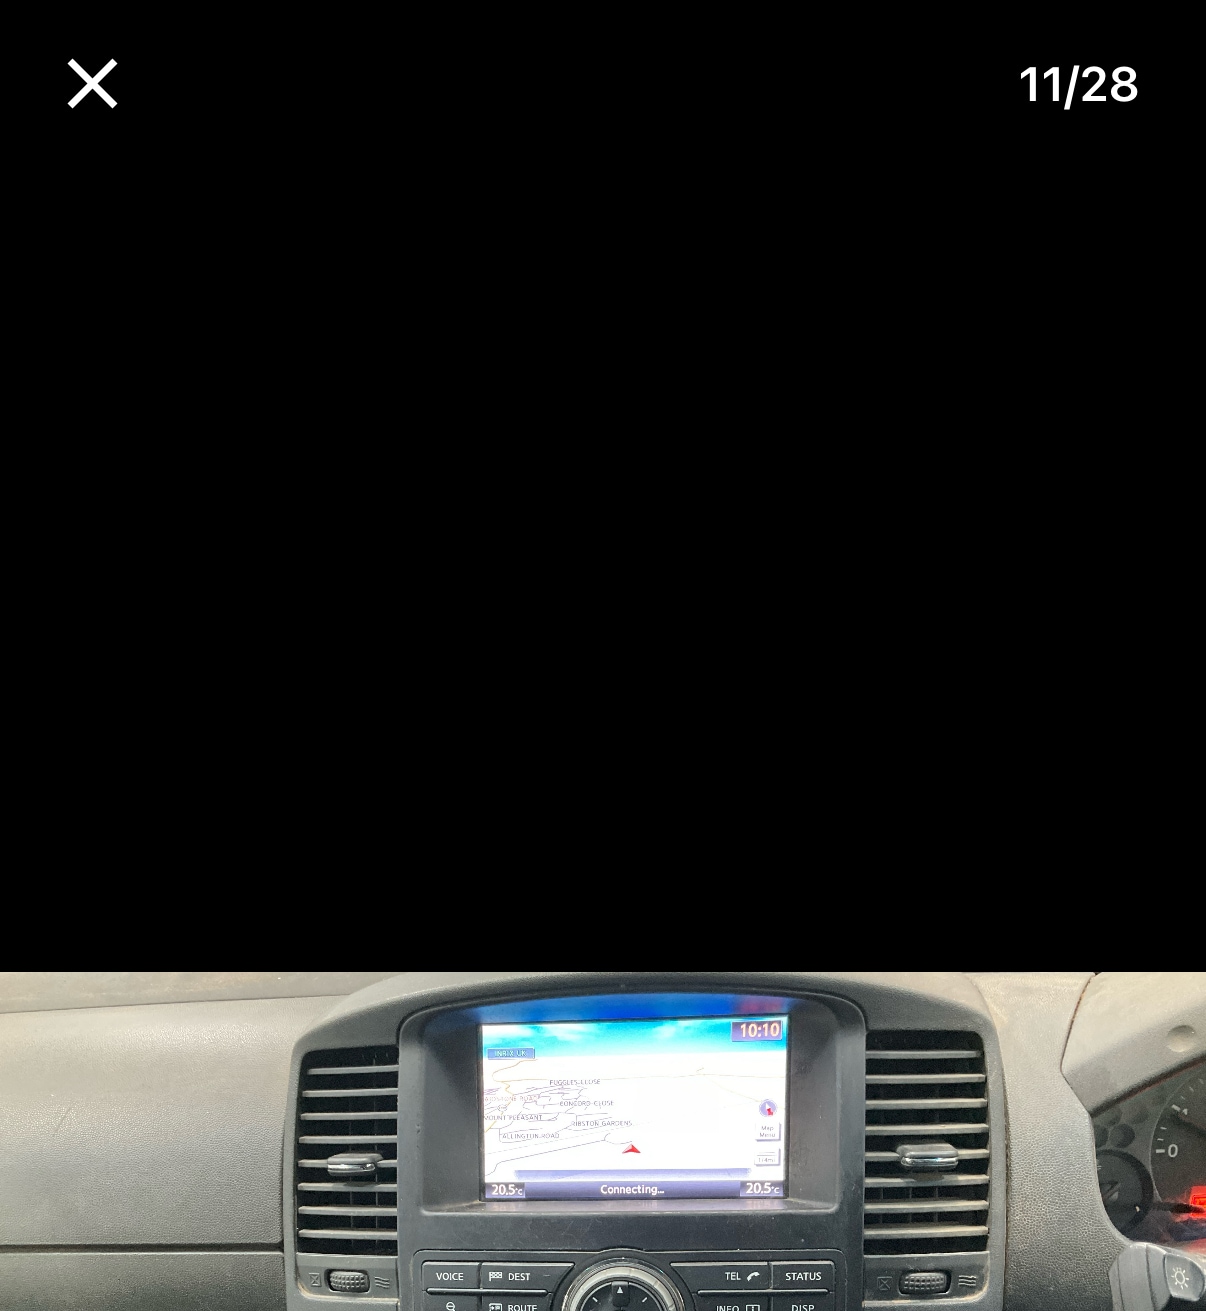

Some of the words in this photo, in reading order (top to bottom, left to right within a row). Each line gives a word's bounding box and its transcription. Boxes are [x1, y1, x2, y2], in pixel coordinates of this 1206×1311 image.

[740, 1023, 780, 1038] 10:10
[1167, 1143, 1179, 1158] 0
[436, 1272, 464, 1281] VOICE
[508, 1272, 531, 1281] DEST
[724, 1271, 742, 1281] TEL
[785, 1271, 822, 1281] STATUS
